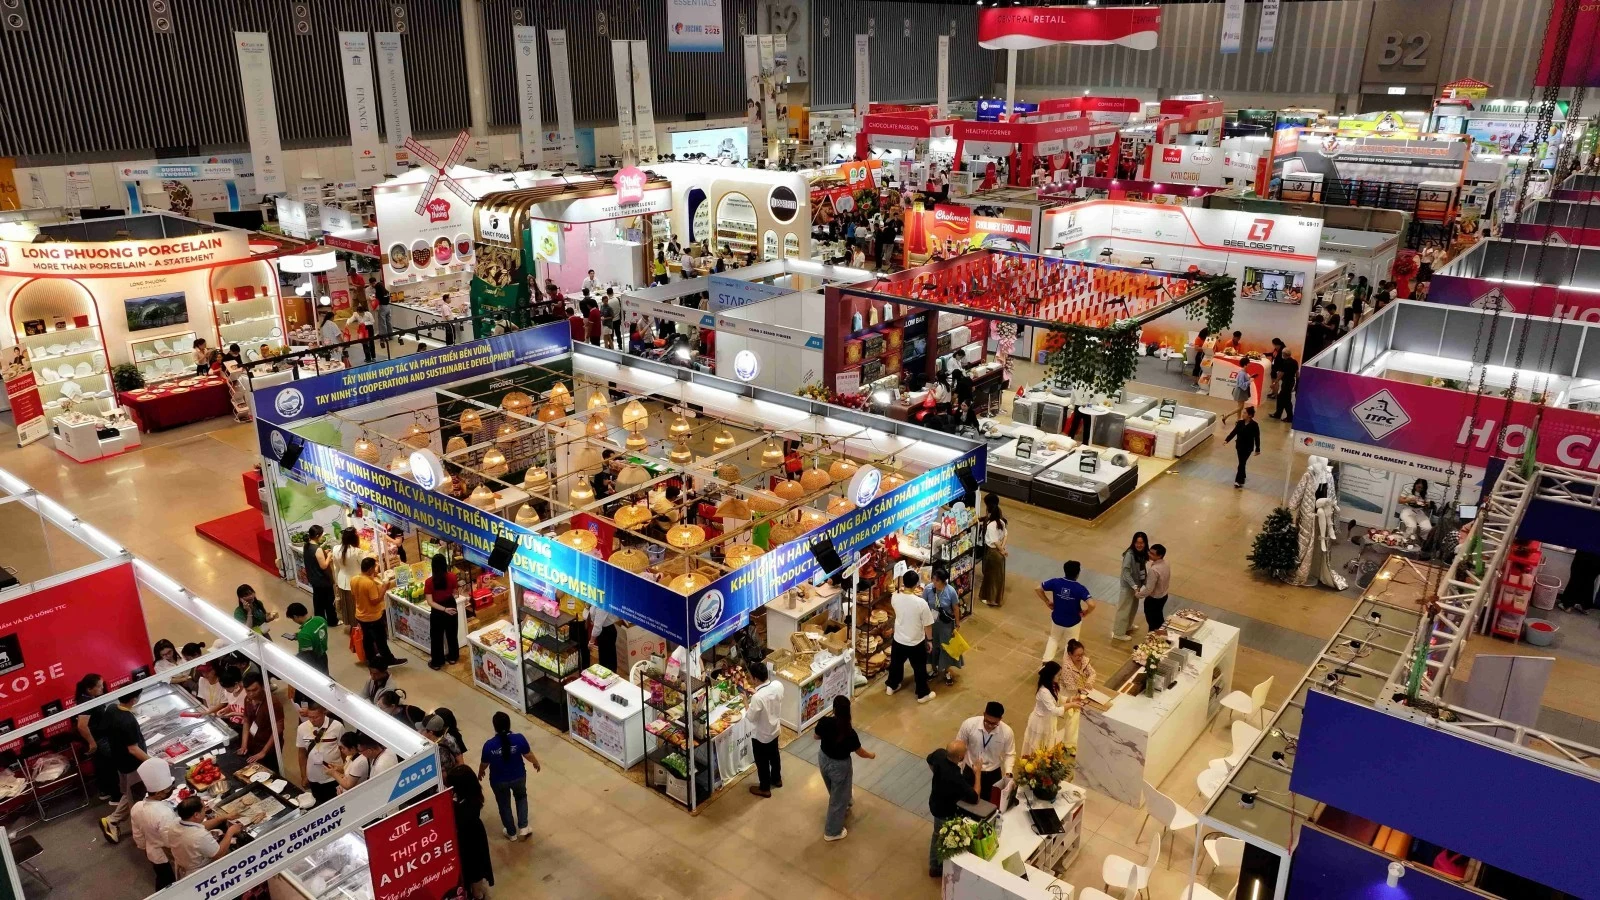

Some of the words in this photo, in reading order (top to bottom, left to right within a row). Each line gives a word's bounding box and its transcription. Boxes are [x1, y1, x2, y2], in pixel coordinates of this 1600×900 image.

[1378, 29, 1432, 66] B2
[355, 87, 369, 131] FINANCE
[525, 73, 534, 120] LOGISTICS
[1480, 104, 1501, 112] NAM
[1503, 105, 1521, 113] VIET
[868, 122, 898, 130] CHOCOLATE
[935, 209, 969, 223] Cholimex
[1001, 223, 1015, 233] FOOD
[1016, 225, 1032, 235] JOINT
[21, 247, 61, 259] LONG
[64, 247, 133, 260] PHUONG
[138, 238, 223, 256] PORCELAIN
[482, 229, 495, 238] FANCY
[495, 232, 510, 240] FOODS
[1223, 239, 1295, 253] BEELOGISTICS
[32, 262, 58, 270] MORE
[61, 262, 87, 271] THAN
[89, 261, 147, 270] PORCELAIN
[154, 259, 162, 267] A
[163, 252, 215, 266] STATEMENT
[315, 393, 330, 406] TAY
[331, 387, 358, 402] NINH'S
[358, 377, 410, 396] COOPERATION
[410, 373, 425, 385] AND
[426, 361, 471, 380] SUSTAINABLE
[470, 349, 516, 369] DEVELOPMENT
[342, 374, 357, 386] TÂY
[357, 370, 378, 382] NINH
[379, 366, 393, 379] HỢP
[394, 361, 409, 375] TÁC
[409, 359, 420, 372] VÀ
[420, 354, 438, 370] PHÁT
[438, 349, 459, 366] TRIỂN
[1364, 413, 1396, 425] ITPC
[1456, 415, 1533, 455] HO
[1340, 447, 1361, 456] THIEN
[1361, 451, 1372, 459] AN
[1373, 454, 1407, 466] GARMENT
[1416, 463, 1443, 473] TEXTILE
[350, 459, 370, 479] NINH
[371, 469, 392, 489] HỢP
[393, 479, 412, 500] TÁC
[411, 487, 427, 504] VÀ
[427, 492, 455, 516] PHÁT
[456, 504, 489, 533] TRIỂN
[298, 458, 314, 474] TAY
[345, 475, 412, 518] COOPERATION
[413, 507, 435, 528] AND
[512, 551, 606, 605] DEVELOPMENT
[730, 572, 756, 594] KHU
[786, 536, 818, 567] HÀNG
[854, 509, 873, 531] BÀY
[874, 501, 893, 521] SẢN
[893, 488, 919, 512] PHẨM
[919, 476, 941, 496] TỈNH
[769, 561, 811, 589] PRODUCT
[849, 533, 870, 551] AREA
[870, 528, 882, 542] OF
[882, 519, 896, 537] TAY
[896, 508, 916, 528] NINH
[915, 484, 952, 516] PROVINCE
[13, 616, 23, 625] VÀ
[54, 603, 67, 612] TTC
[398, 764, 433, 788] C10,12
[194, 875, 221, 893] TTC
[221, 854, 256, 881] FOOD
[259, 839, 286, 859] AND
[289, 805, 347, 841] BEVERAGE
[204, 874, 242, 900] JOINT
[245, 851, 285, 879] STOCK
[286, 818, 344, 855] COMPANY
[390, 841, 418, 862] THỊT
[421, 829, 438, 848] BÒ
